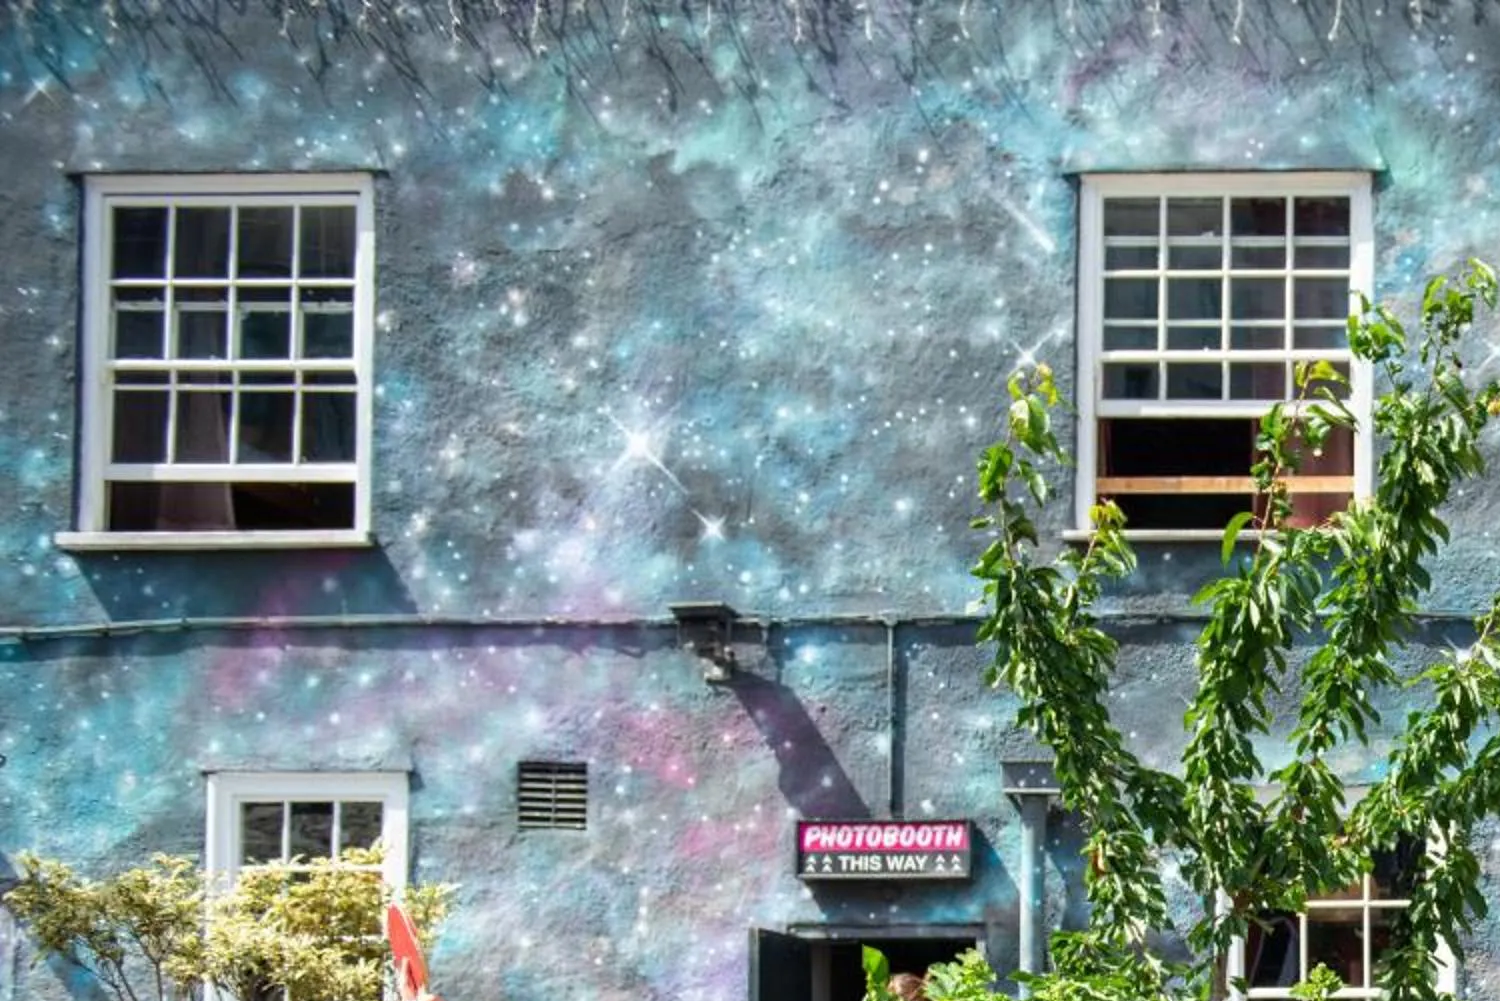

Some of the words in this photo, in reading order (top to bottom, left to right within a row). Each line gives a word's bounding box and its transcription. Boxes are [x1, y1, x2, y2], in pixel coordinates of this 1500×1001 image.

[804, 825, 963, 848] PHOTOBOOTH
[838, 855, 882, 871] THIS
[886, 855, 928, 871] WAY
